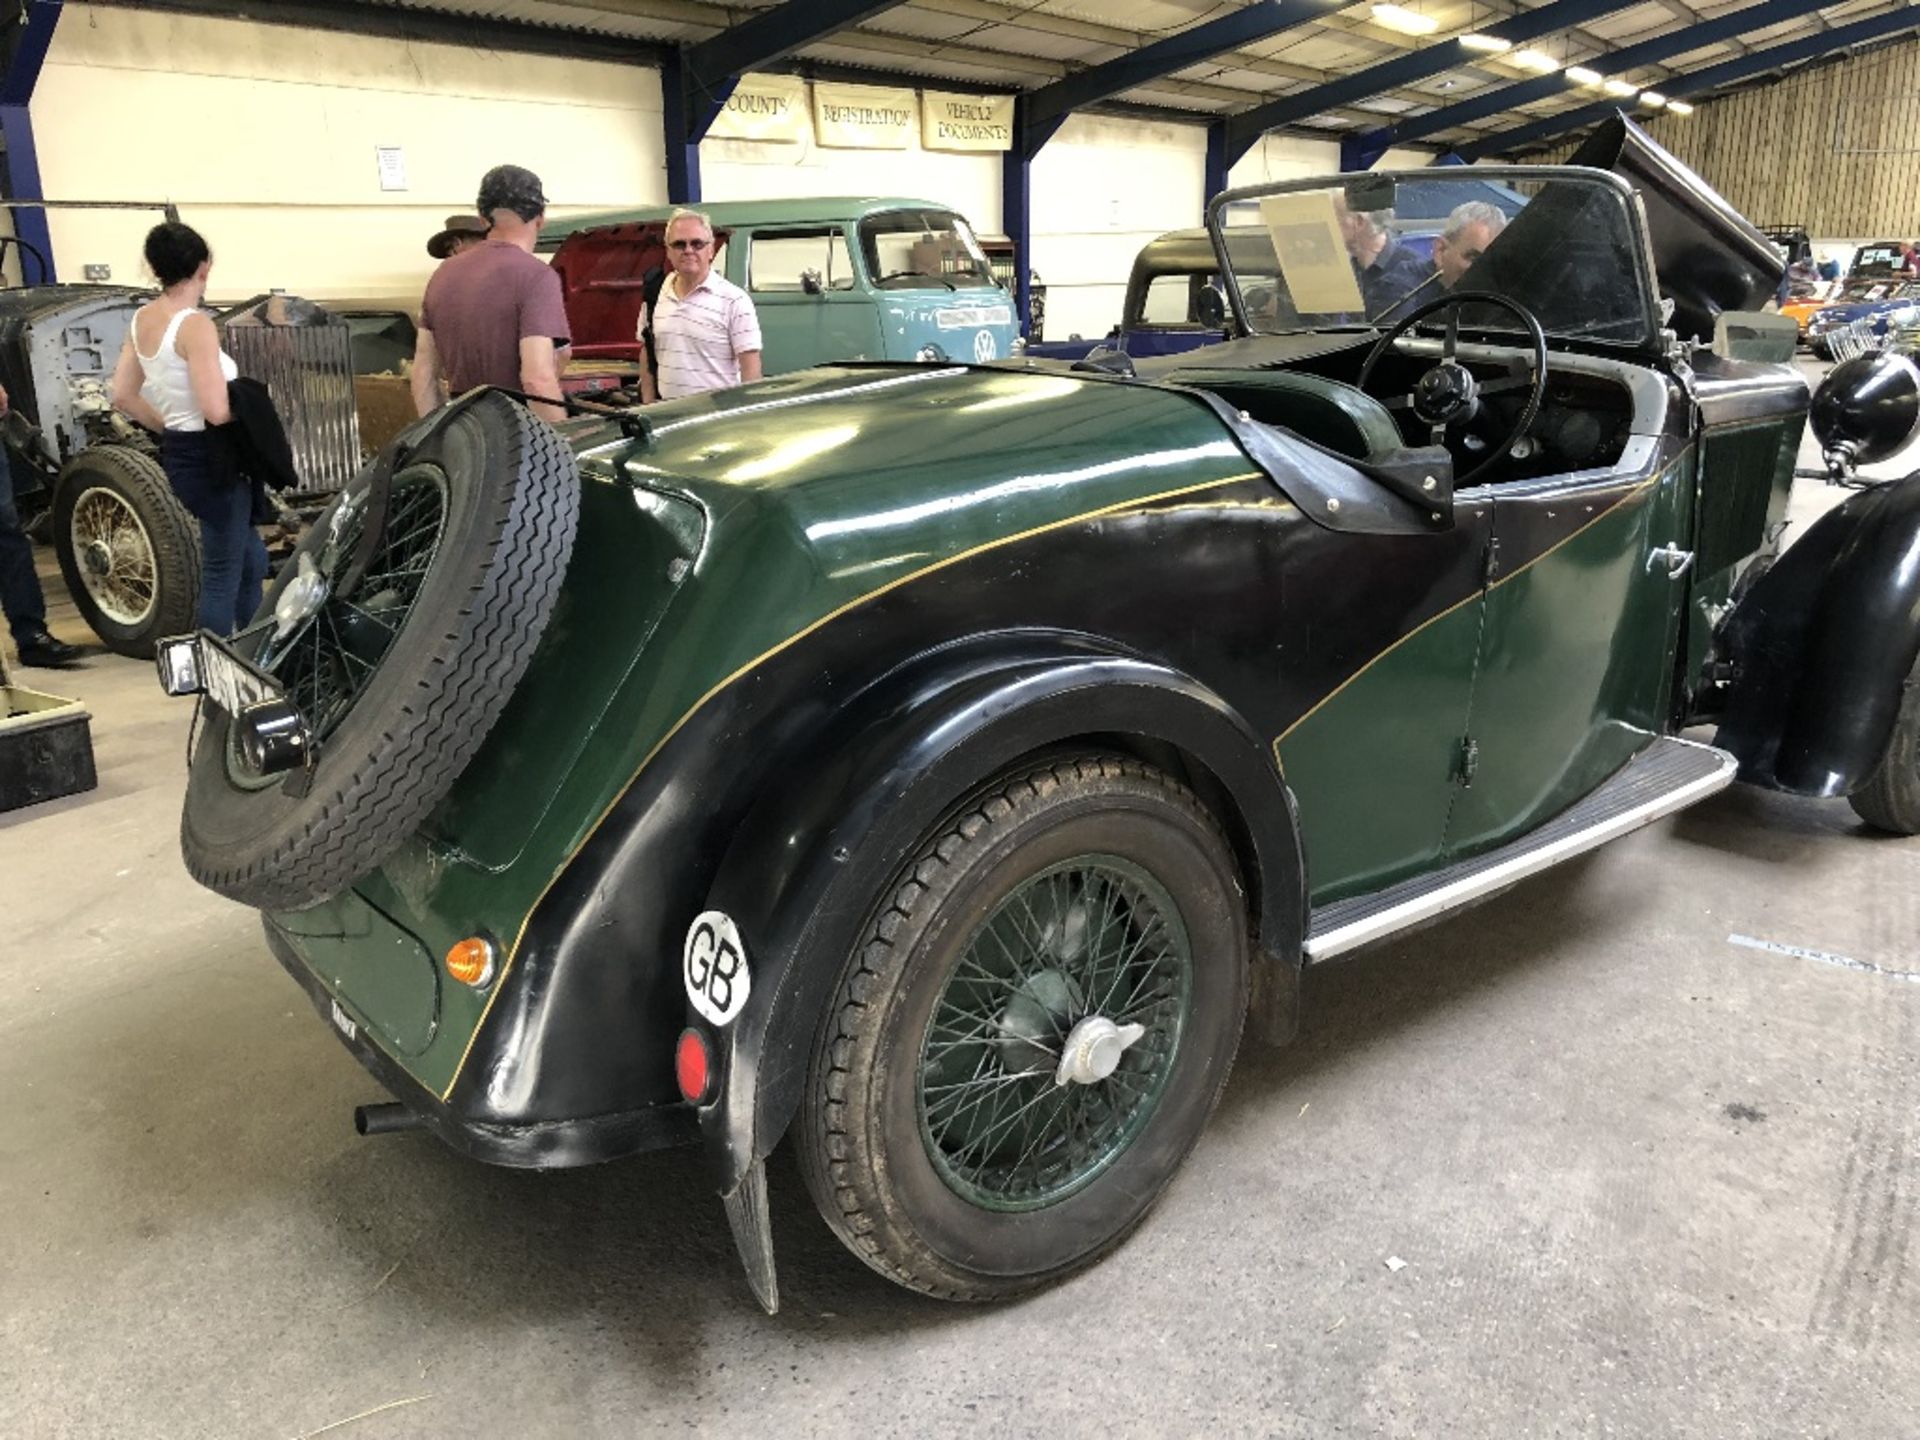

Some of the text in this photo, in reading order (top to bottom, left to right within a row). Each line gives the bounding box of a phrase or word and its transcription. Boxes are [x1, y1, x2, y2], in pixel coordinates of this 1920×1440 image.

[823, 104, 911, 126] REGISTRATION
[946, 102, 993, 121] VEHICLE
[938, 121, 1008, 140] DOCUMENTS
[688, 922, 739, 1013] GB
